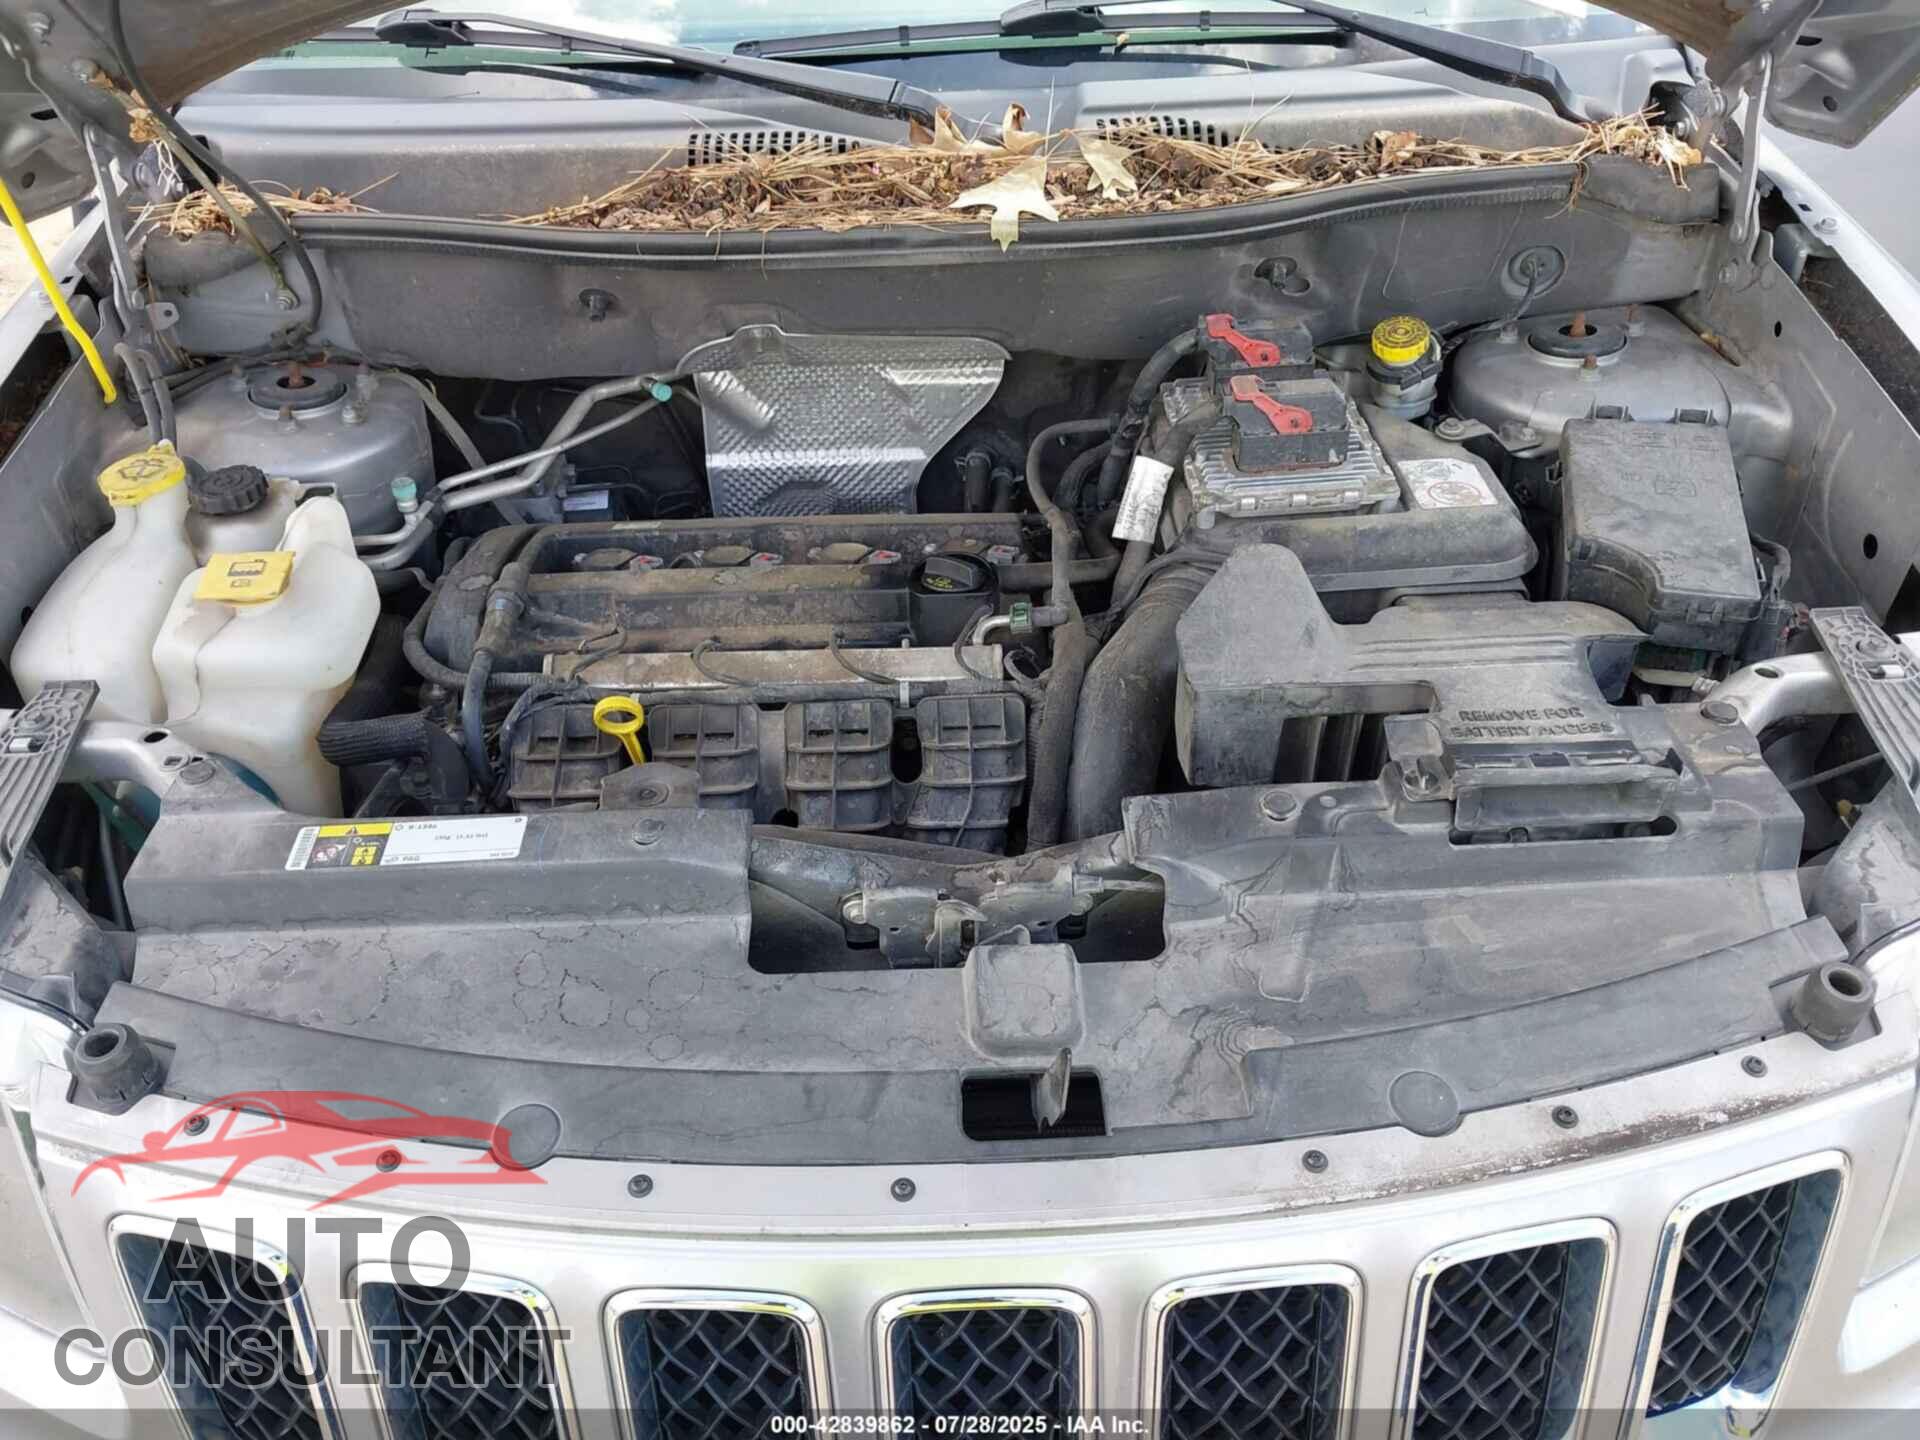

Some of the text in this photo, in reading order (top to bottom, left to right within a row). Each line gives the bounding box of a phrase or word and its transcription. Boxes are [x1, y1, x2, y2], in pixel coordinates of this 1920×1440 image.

[1458, 706, 1585, 722] REMOVE FOR
[1451, 720, 1615, 738] BATTERY ACCESS
